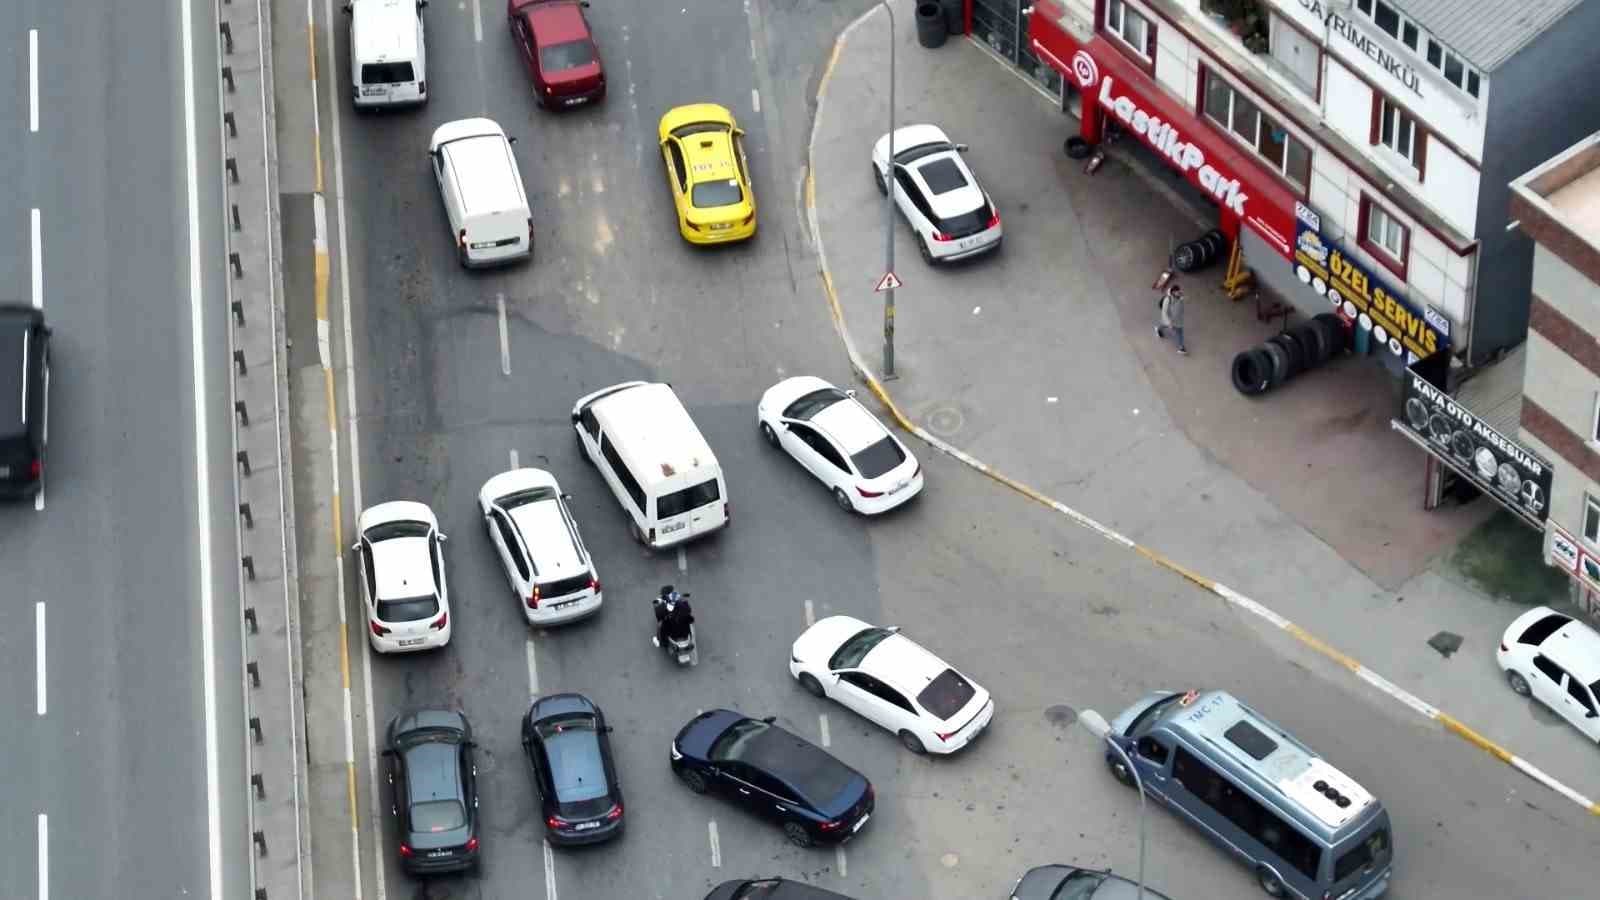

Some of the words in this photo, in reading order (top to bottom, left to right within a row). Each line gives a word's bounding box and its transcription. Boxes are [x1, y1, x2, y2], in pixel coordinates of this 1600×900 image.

[1099, 76, 1248, 216] LastikPark
[1330, 249, 1371, 302] ÖZEL
[1373, 288, 1437, 353] SERVİS
[1413, 377, 1445, 409] KAYA
[1447, 401, 1472, 426] OTO
[1474, 421, 1543, 476] AKSESUAR
